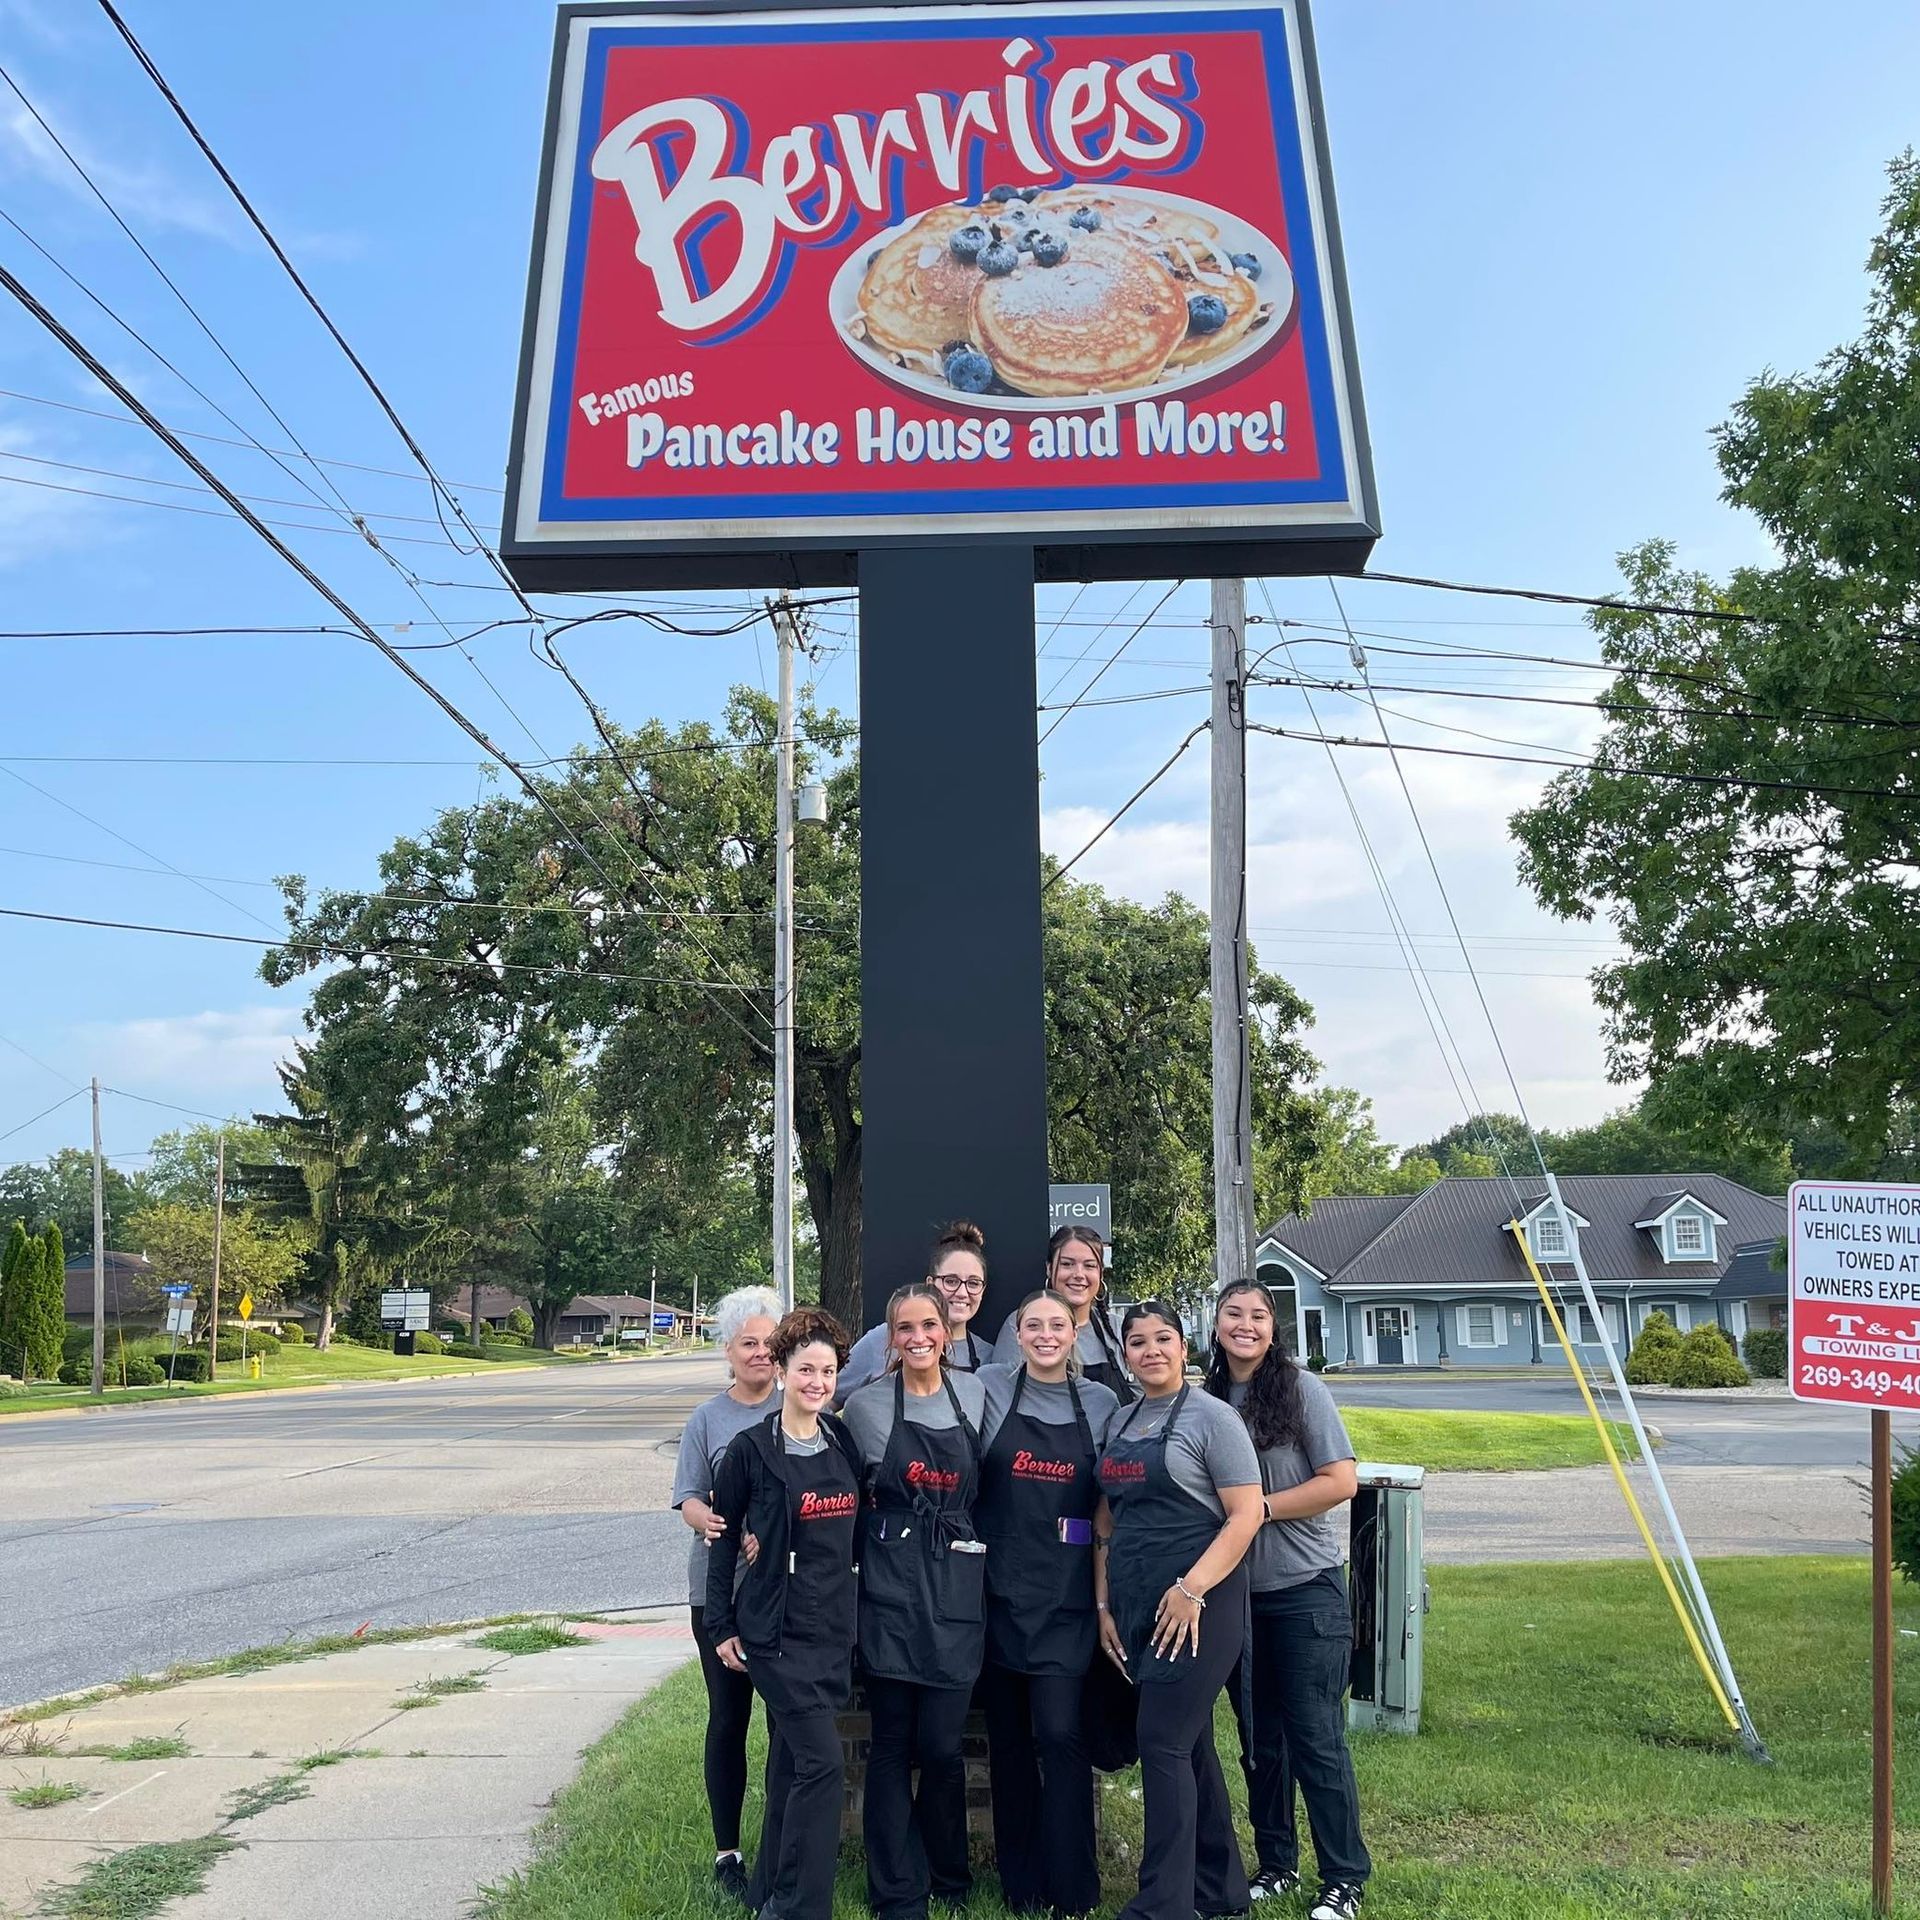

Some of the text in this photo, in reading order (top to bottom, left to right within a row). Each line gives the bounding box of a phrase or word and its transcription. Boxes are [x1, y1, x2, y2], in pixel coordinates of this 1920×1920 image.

[591, 36, 1191, 333] Berries
[579, 370, 695, 427] Famous
[626, 400, 1285, 468] Pancake House and More!
[1798, 1194, 1920, 1216] ALL UNAUTHOR
[1804, 1221, 1882, 1242] VEHICLES
[1836, 1251, 1920, 1272] TOWED AT
[1804, 1276, 1920, 1301] OWNERS EXPE
[1826, 1313, 1920, 1342] T & J
[1817, 1339, 1897, 1358] TOWING
[1012, 1450, 1075, 1477] Berrie's
[800, 1491, 856, 1515] Berrie's
